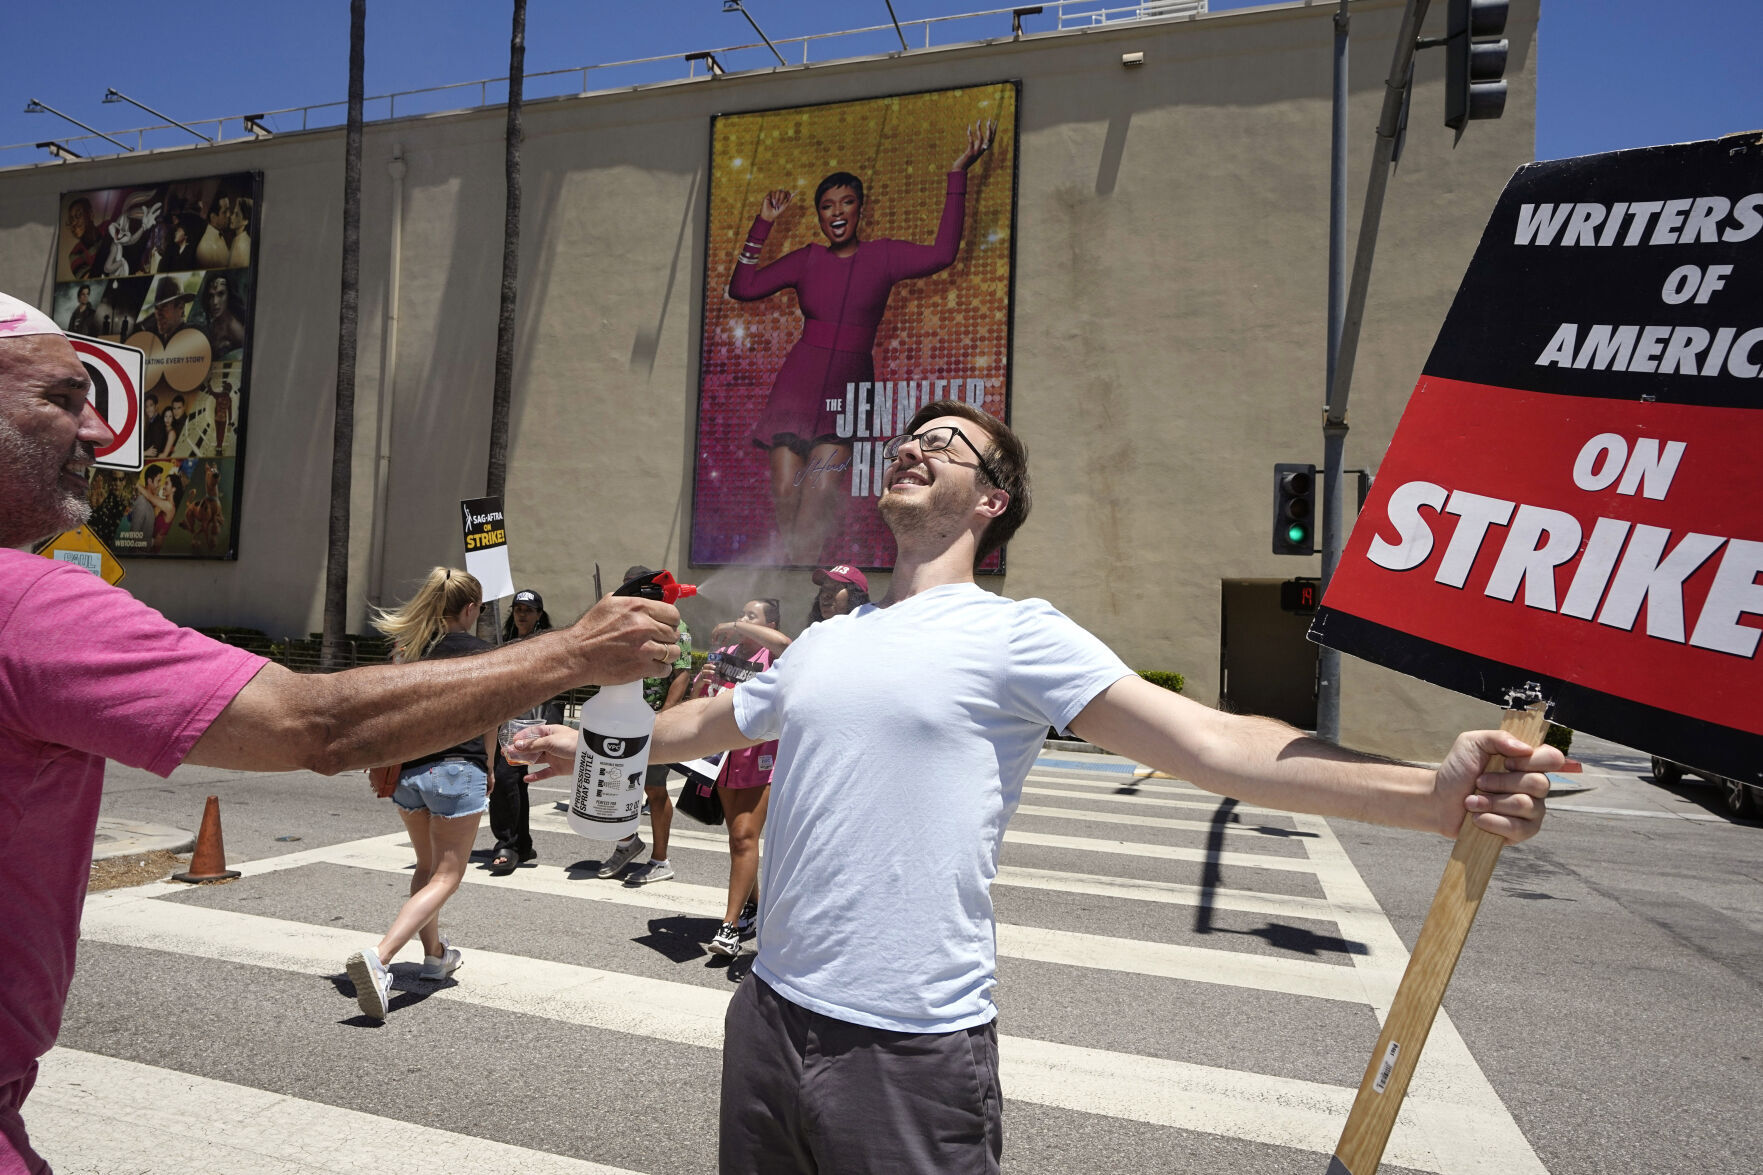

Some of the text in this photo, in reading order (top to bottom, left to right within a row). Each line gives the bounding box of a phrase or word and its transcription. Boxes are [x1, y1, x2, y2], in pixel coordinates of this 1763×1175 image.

[1514, 193, 1763, 247] WRITERS
[1661, 264, 1734, 305] OF
[165, 357, 184, 365] EVERY
[186, 356, 205, 364] STORY
[1534, 323, 1763, 378] AMERIC
[825, 399, 842, 411] THE
[1572, 432, 1688, 500] ON
[466, 530, 505, 548] STRIKE!
[1366, 481, 1763, 659] STRIKE
[574, 751, 587, 808] PROFESSIONAL
[580, 754, 593, 811] SPRAY BOTTLE
[625, 803, 633, 812] 32
